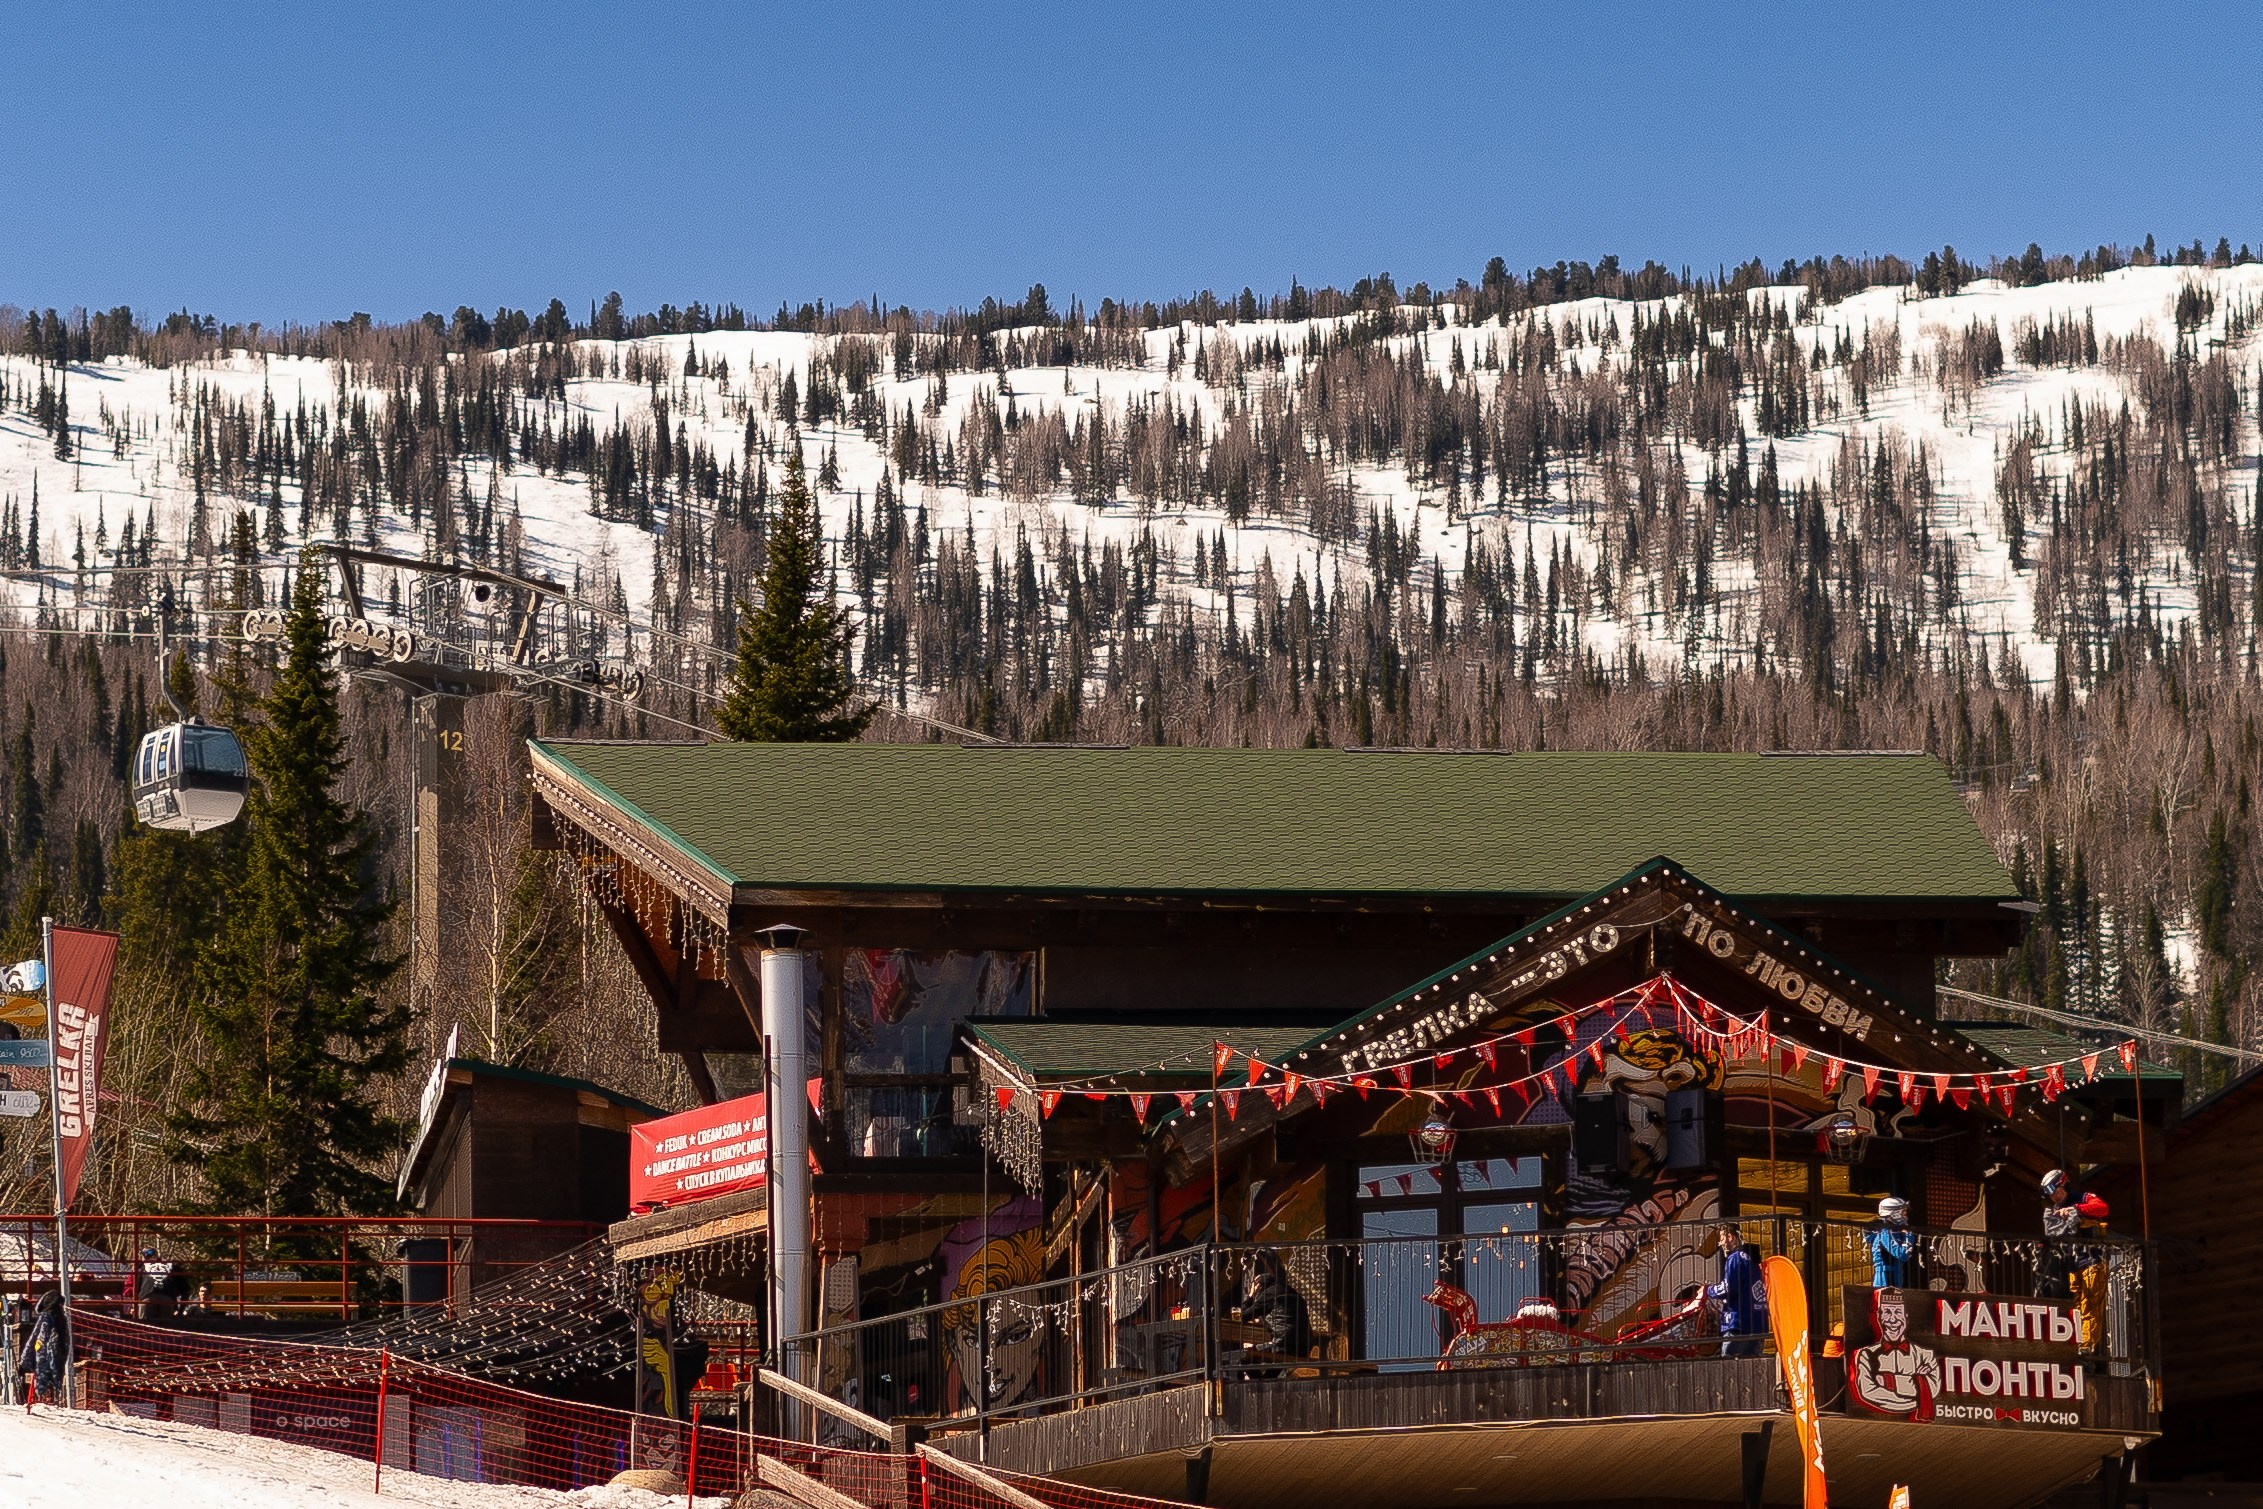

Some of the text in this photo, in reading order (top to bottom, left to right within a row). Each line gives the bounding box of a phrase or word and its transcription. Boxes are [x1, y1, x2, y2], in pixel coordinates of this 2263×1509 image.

[440, 730, 463, 751] 12
[1683, 910, 1873, 1042] ПО ЛЮБВИ
[1341, 992, 1498, 1073] ГРЕЛКА
[1533, 924, 1619, 986] ЭТО
[85, 1034, 94, 1056] BAR
[57, 1002, 86, 1138] GRELKA
[84, 1059, 93, 1078] SKI
[1939, 1299, 2084, 1344] МАНТЫ
[1944, 1357, 2085, 1400] ПОНТЫ
[294, 1416, 350, 1431] space
[1935, 1404, 2079, 1425] БЫСТРО ВКУСНО
